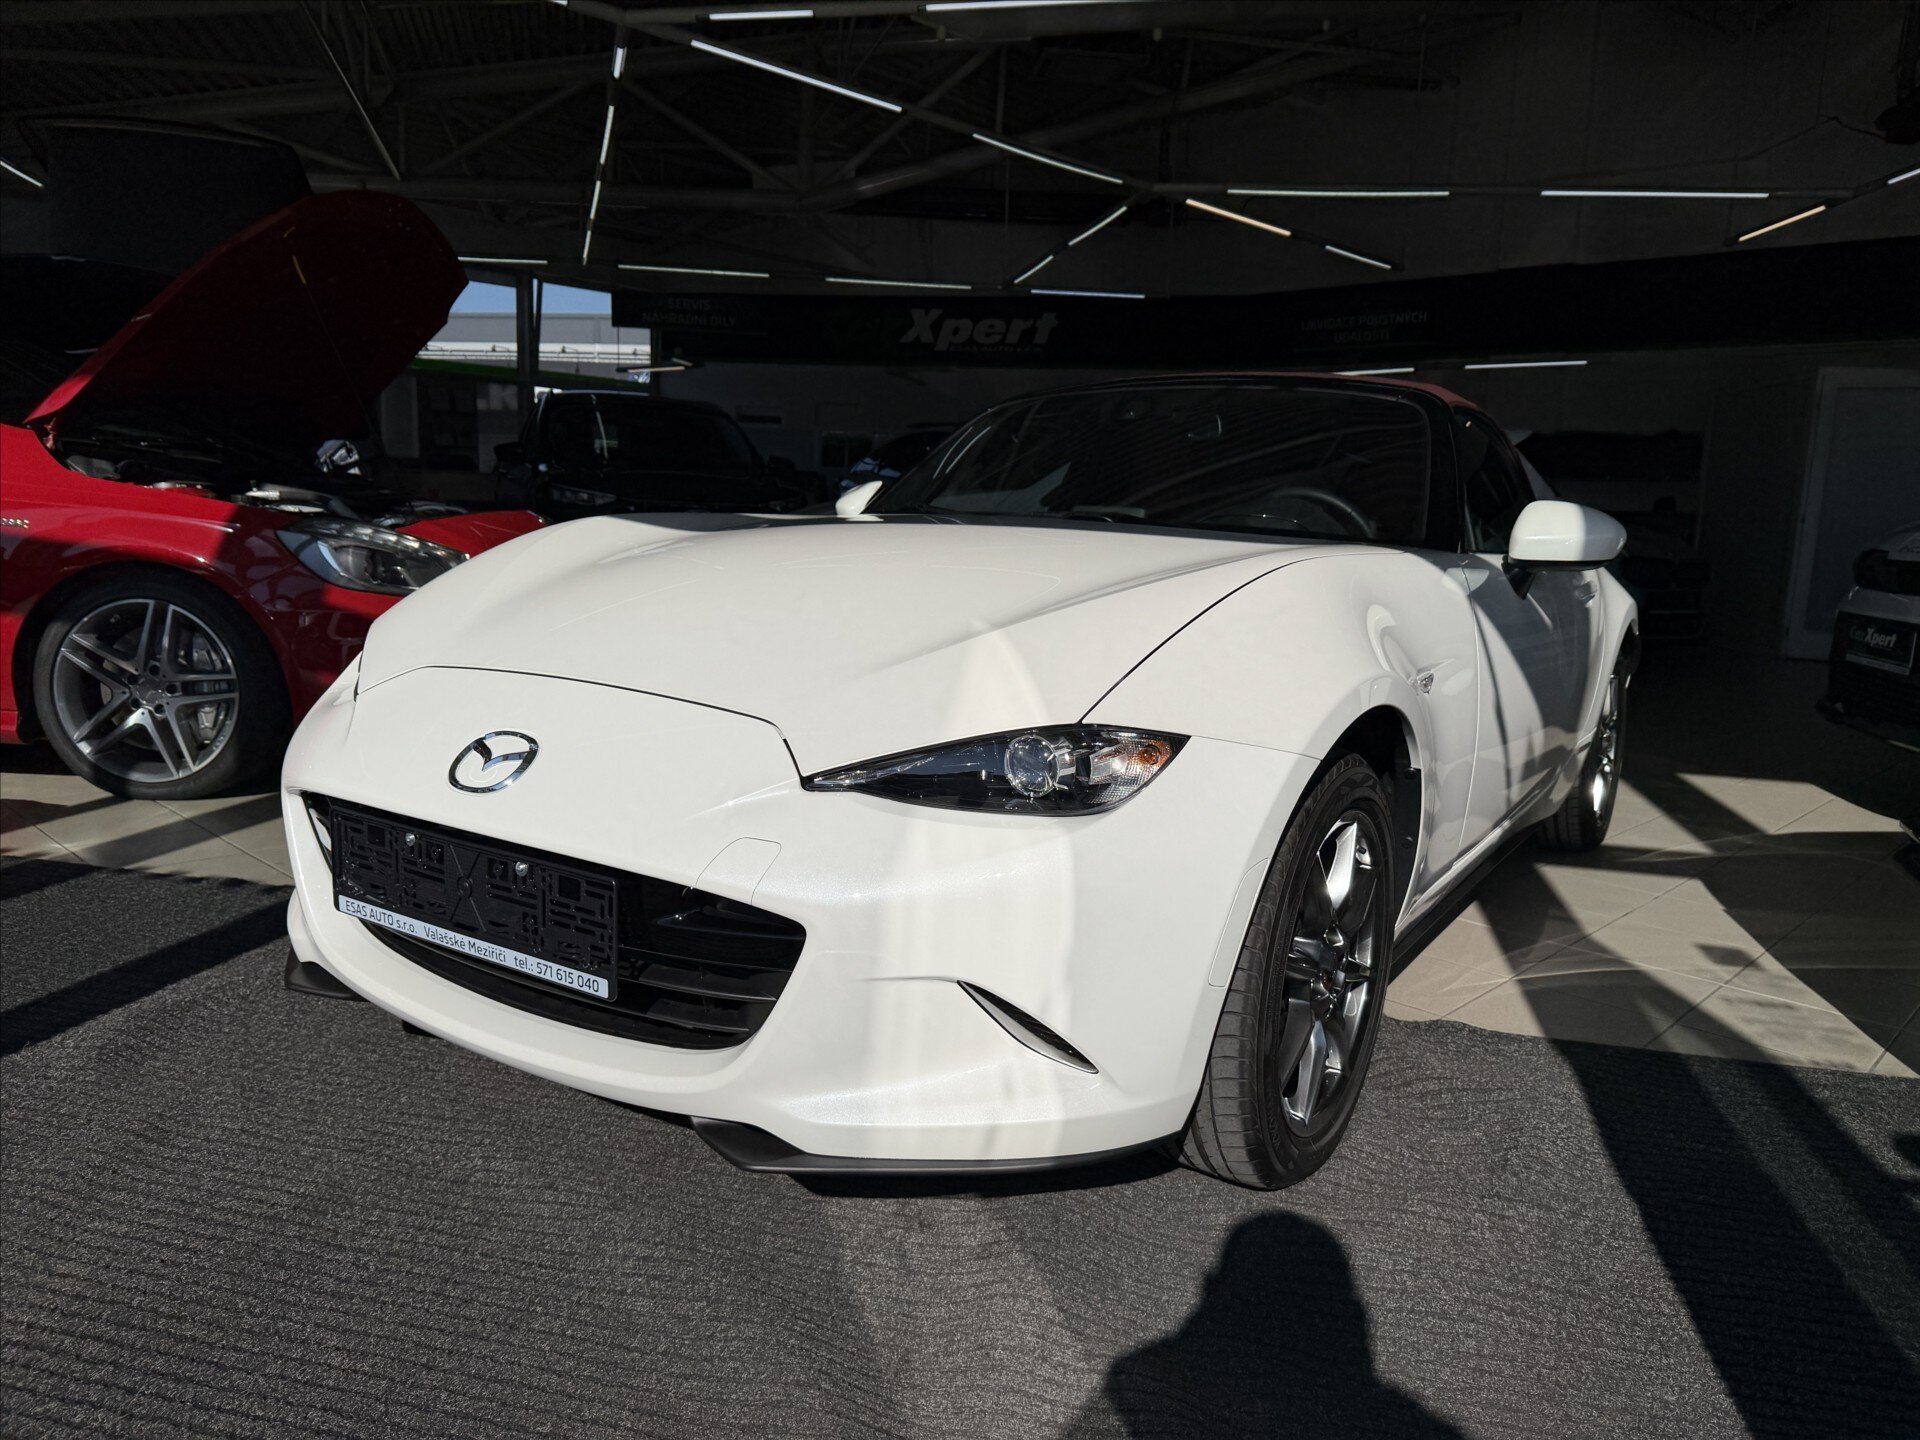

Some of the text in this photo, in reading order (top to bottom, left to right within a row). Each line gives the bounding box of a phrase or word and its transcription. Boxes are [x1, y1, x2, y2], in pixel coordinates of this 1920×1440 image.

[346, 900, 367, 917] ESAS
[369, 908, 394, 926] AUTO
[396, 919, 418, 934] s.r.o.
[423, 925, 466, 950] Valašské
[514, 955, 534, 972] tel.:
[536, 961, 553, 978] 571
[556, 968, 574, 985] 615
[577, 974, 600, 993] 040
